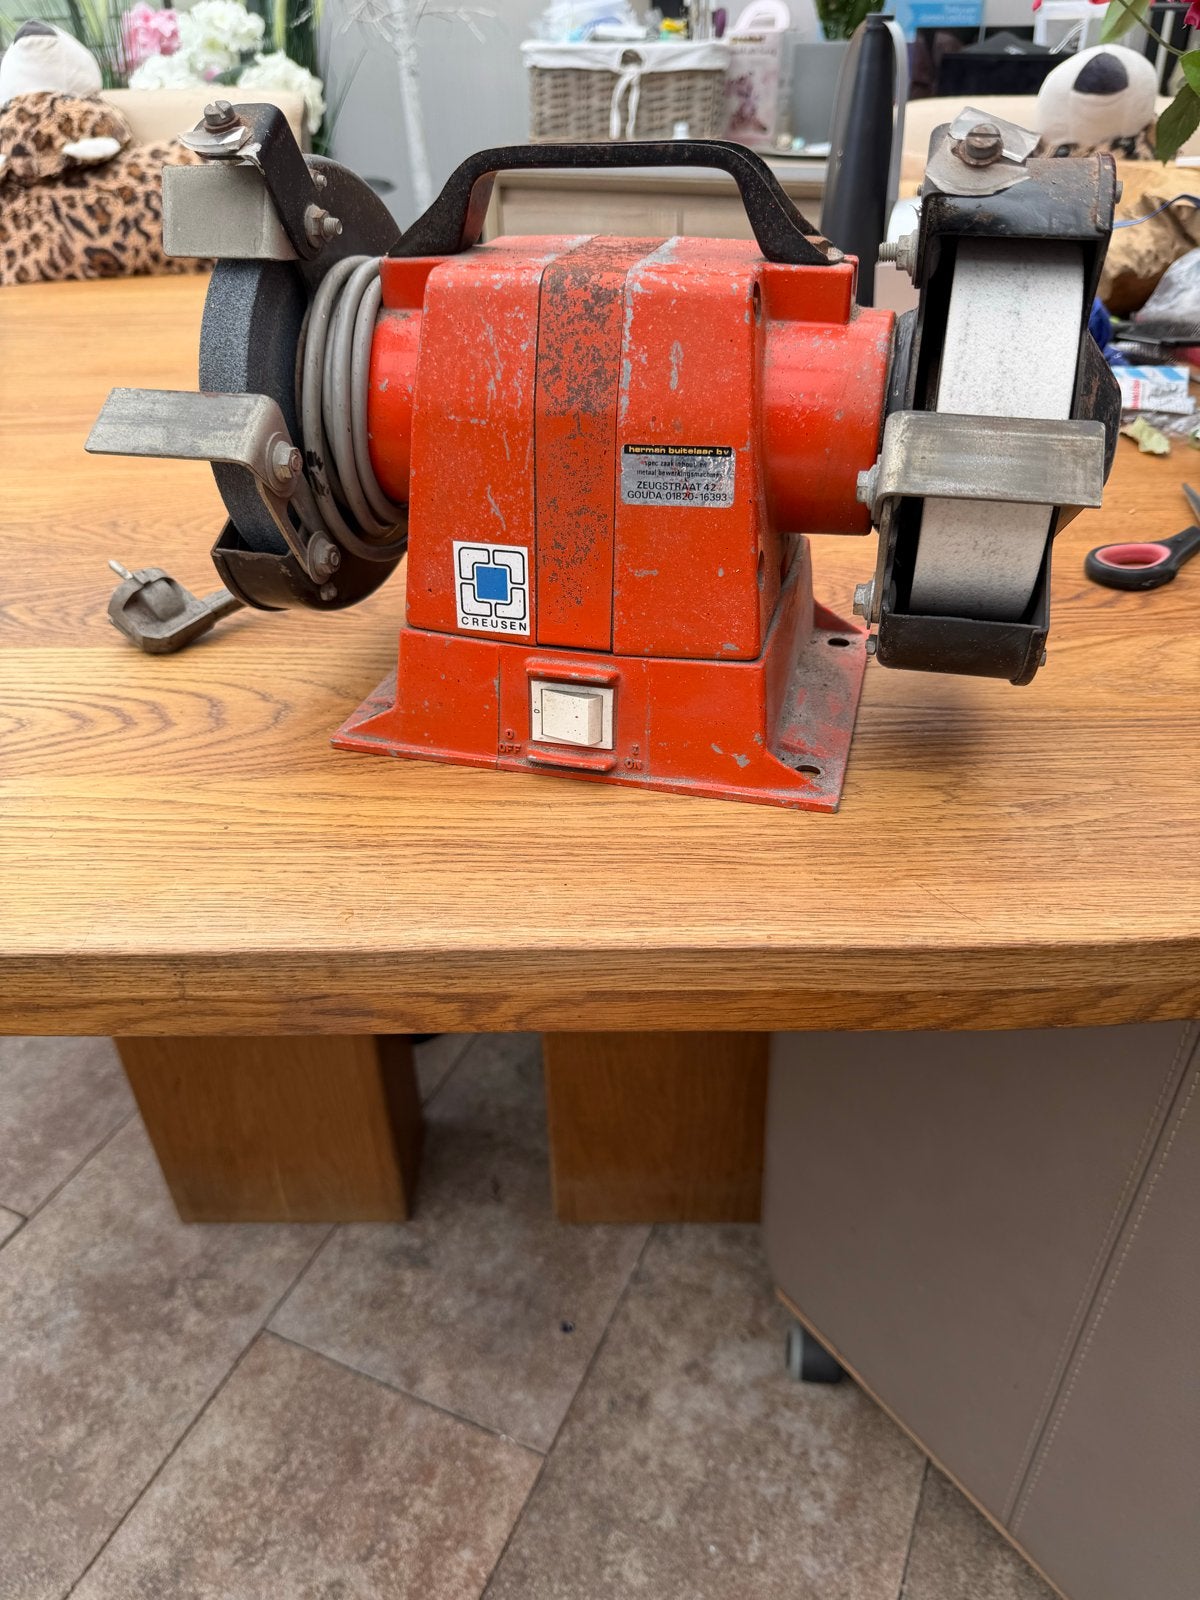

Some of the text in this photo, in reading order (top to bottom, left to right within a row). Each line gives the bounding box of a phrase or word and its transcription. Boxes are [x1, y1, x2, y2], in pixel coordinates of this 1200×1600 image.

[628, 446, 666, 454] herman
[637, 481, 717, 492] ZEUGSTRAAT 42
[461, 616, 527, 631] CREUSEN
[499, 743, 522, 754] OFF
[624, 757, 643, 771] ON
